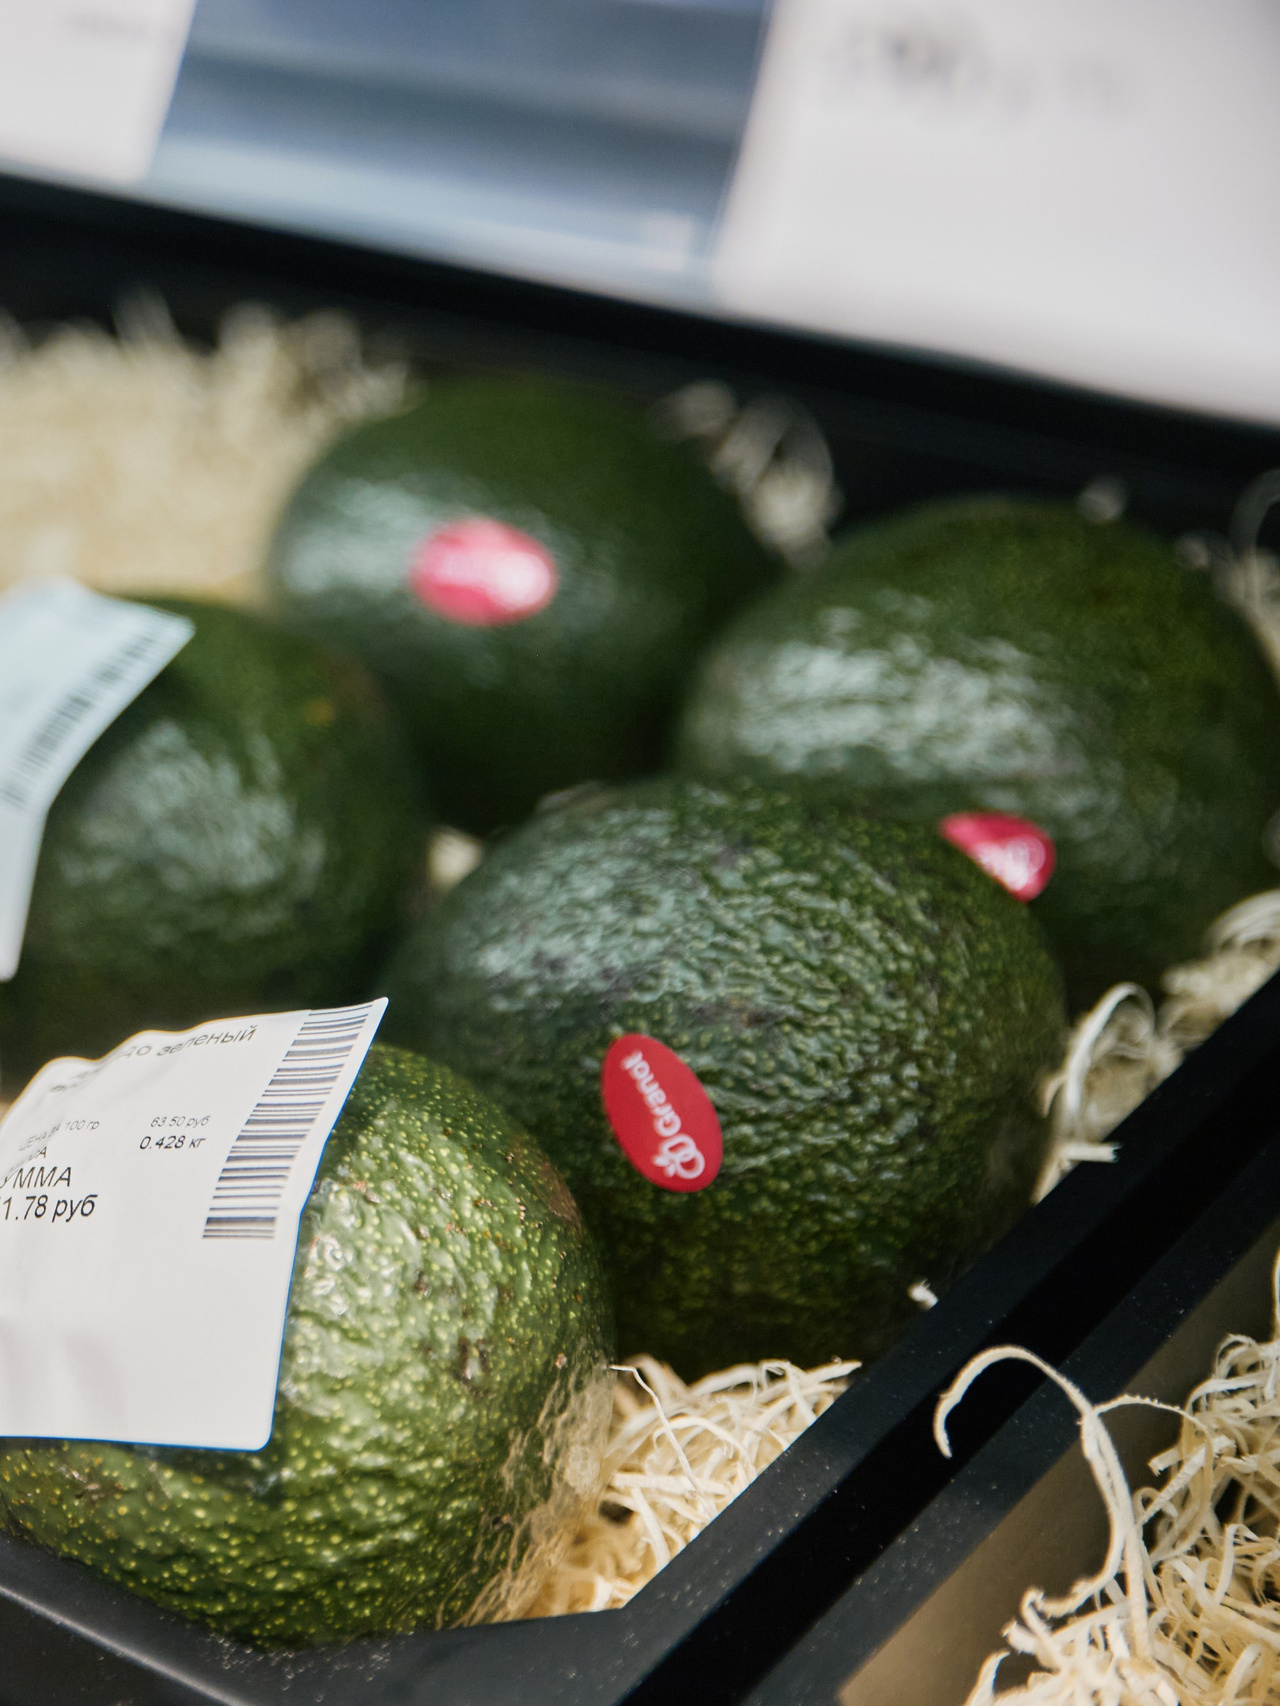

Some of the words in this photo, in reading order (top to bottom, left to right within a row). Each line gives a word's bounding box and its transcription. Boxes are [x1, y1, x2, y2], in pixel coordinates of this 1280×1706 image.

[157, 1024, 259, 1056] зеленый
[65, 1120, 86, 1131] 100
[150, 1116, 186, 1128] 63.50
[186, 1115, 211, 1129] руб
[139, 1135, 186, 1150] 0.428
[188, 1138, 206, 1149] кг
[51, 1194, 99, 1223] руб
